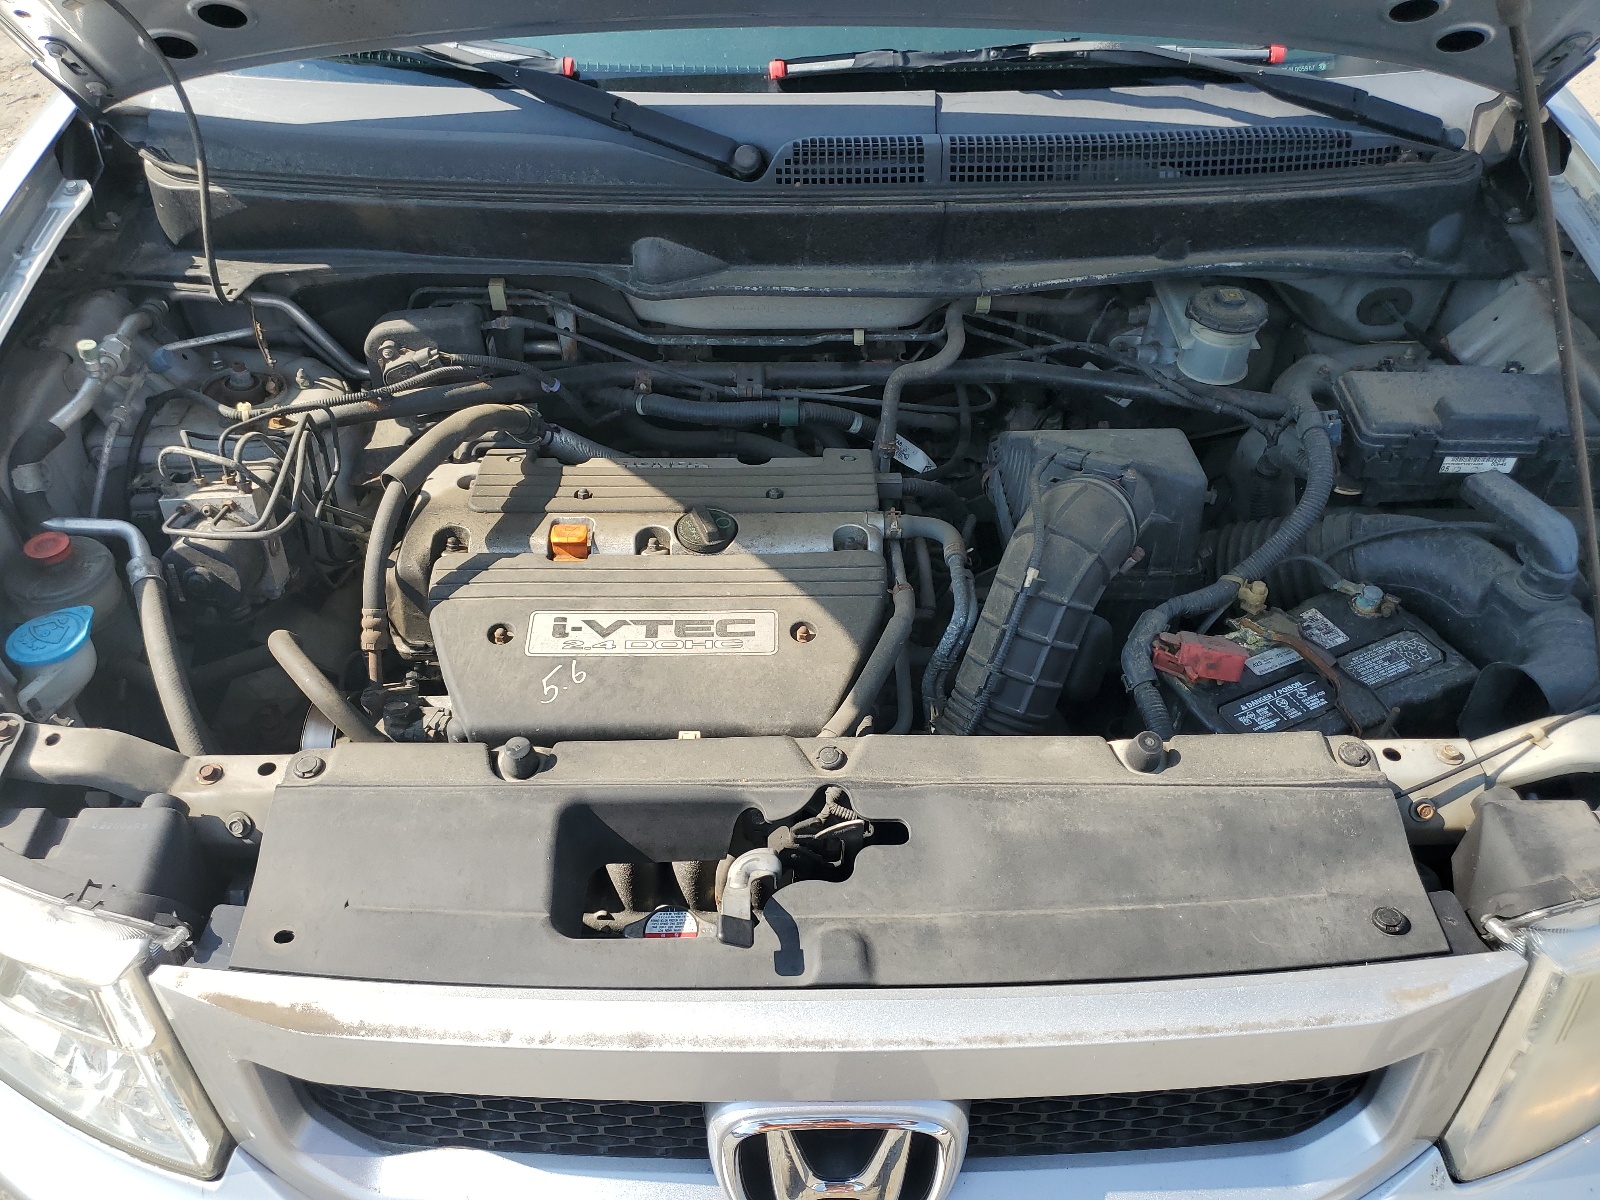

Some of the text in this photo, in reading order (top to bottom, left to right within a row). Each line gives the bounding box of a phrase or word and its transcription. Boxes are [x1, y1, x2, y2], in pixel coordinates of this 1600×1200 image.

[551, 616, 756, 639] i-VTEC
[561, 638, 745, 650] 2.4 DOHC
[1246, 693, 1274, 708] DANGER
[1276, 681, 1303, 696] POISON
